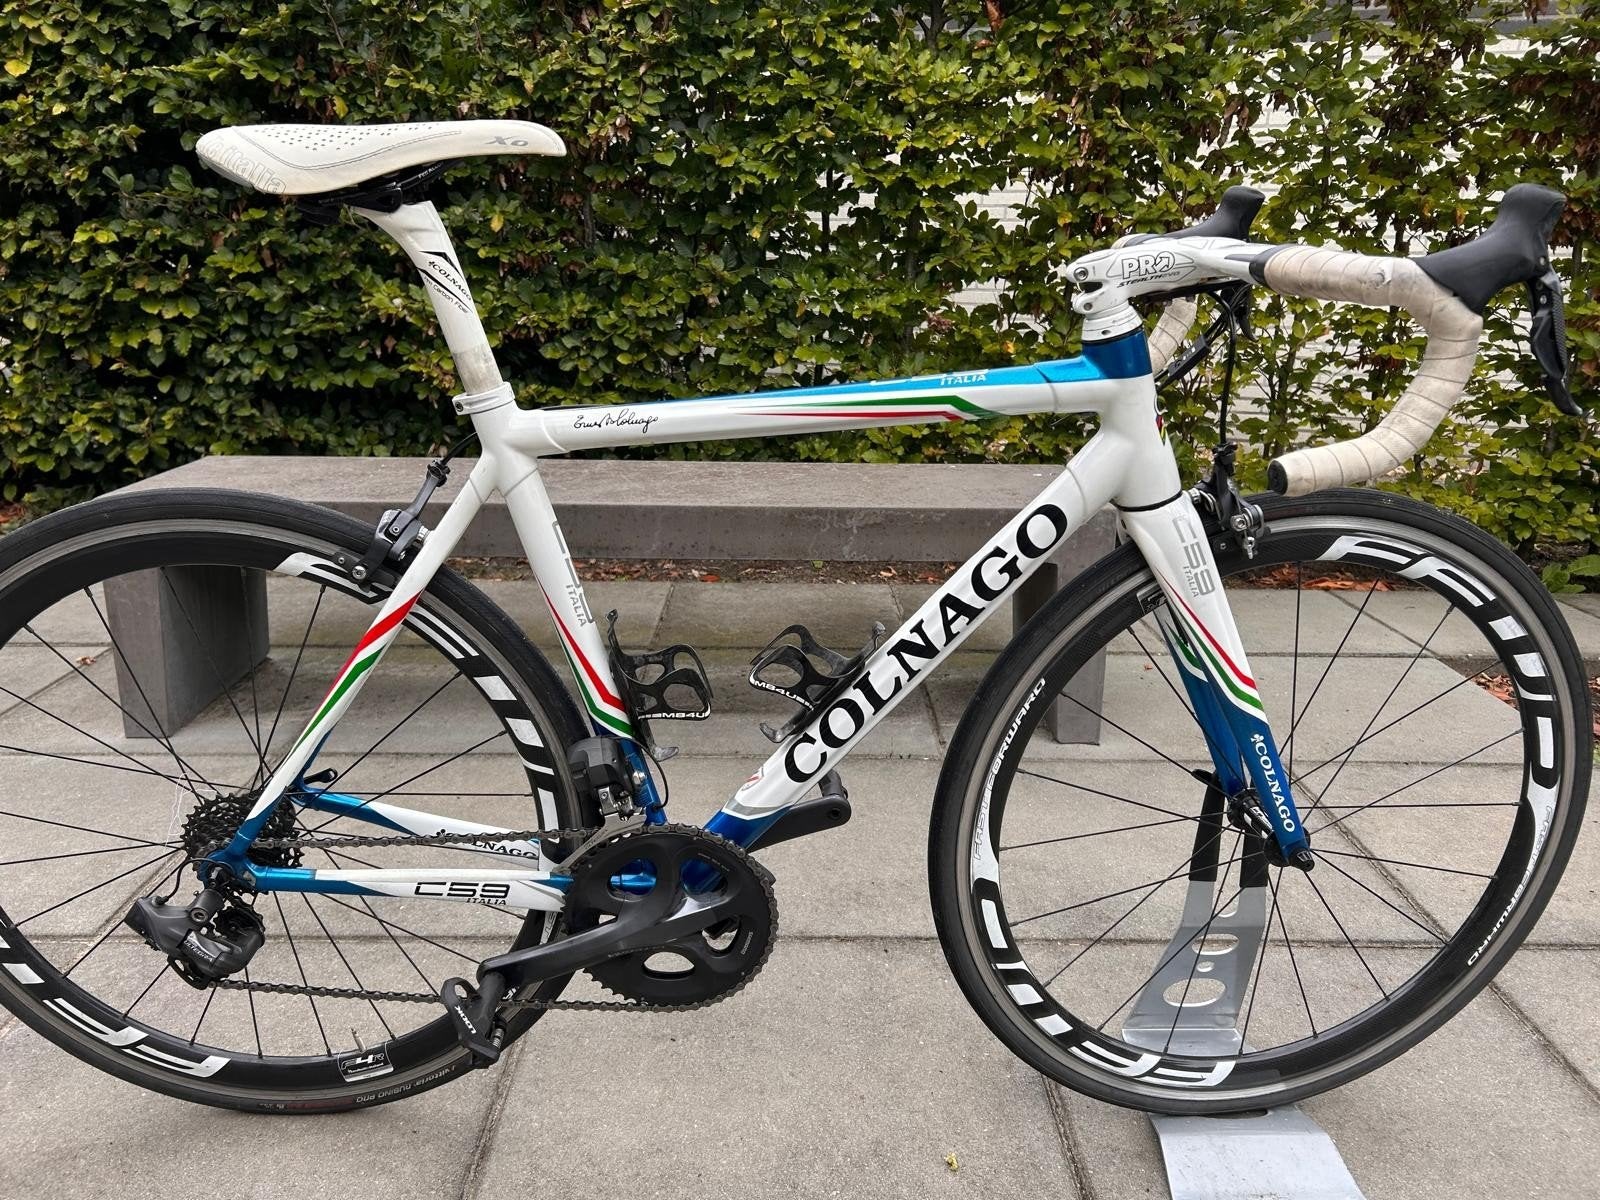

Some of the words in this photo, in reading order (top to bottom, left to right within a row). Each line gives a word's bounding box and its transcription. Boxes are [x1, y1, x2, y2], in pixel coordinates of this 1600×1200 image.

[1121, 250, 1176, 280] PRO
[432, 263, 472, 301] COLNAGO
[940, 373, 987, 386] ITALIA
[1172, 515, 1216, 596] C59
[1183, 565, 1200, 598] ITALIA
[565, 583, 588, 628] ITALIA
[784, 503, 1068, 783] COLNAGO
[1255, 741, 1296, 833] COLNAGO
[414, 881, 511, 899] C59
[466, 897, 508, 906] ITALIA
[454, 1005, 477, 1035] LOOK
